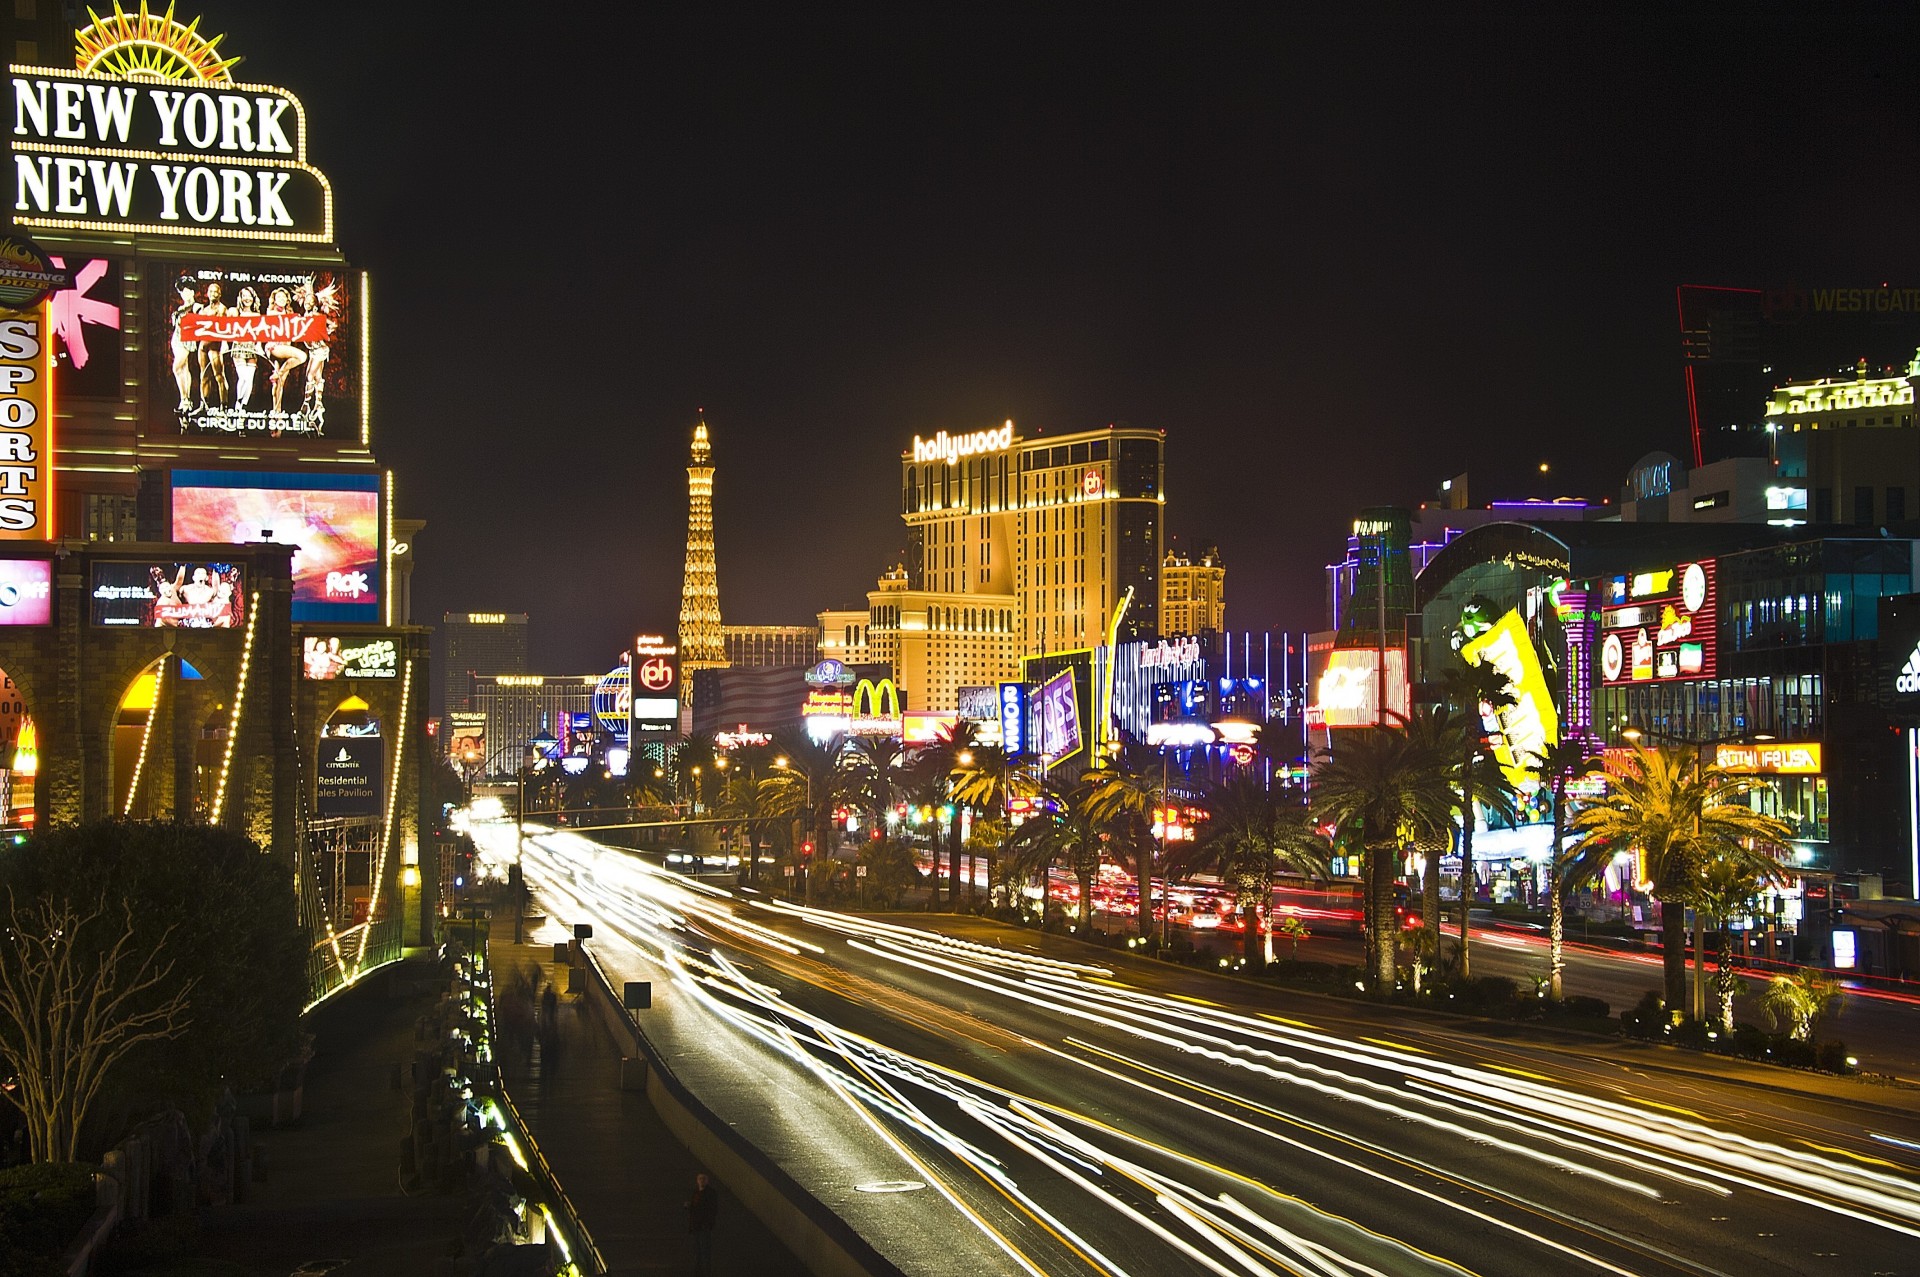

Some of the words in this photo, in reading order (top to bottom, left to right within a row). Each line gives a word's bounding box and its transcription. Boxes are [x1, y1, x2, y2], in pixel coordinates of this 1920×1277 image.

[12, 78, 137, 143] NEW
[150, 90, 293, 154] YORK
[14, 155, 138, 217] NEW
[151, 165, 294, 226] YORK
[0, 278, 49, 290] OUSE
[198, 270, 223, 281] SEXY
[230, 272, 250, 282] FUN
[257, 274, 312, 284] ACROBATIC
[1812, 288, 1920, 312] WESTGATE
[194, 315, 315, 342] ZUMANITY
[0, 320, 38, 531] SPORTS
[197, 417, 244, 432] CIRQUE
[248, 419, 266, 430] DU
[913, 419, 1013, 465] hollywood
[468, 613, 506, 624] TRUMP
[645, 659, 673, 686] ph
[1895, 673, 1920, 693] adi
[1003, 685, 1020, 753] ROSS
[318, 775, 368, 785] Residential
[318, 788, 337, 797] ales
[338, 788, 373, 797] Pavilion
